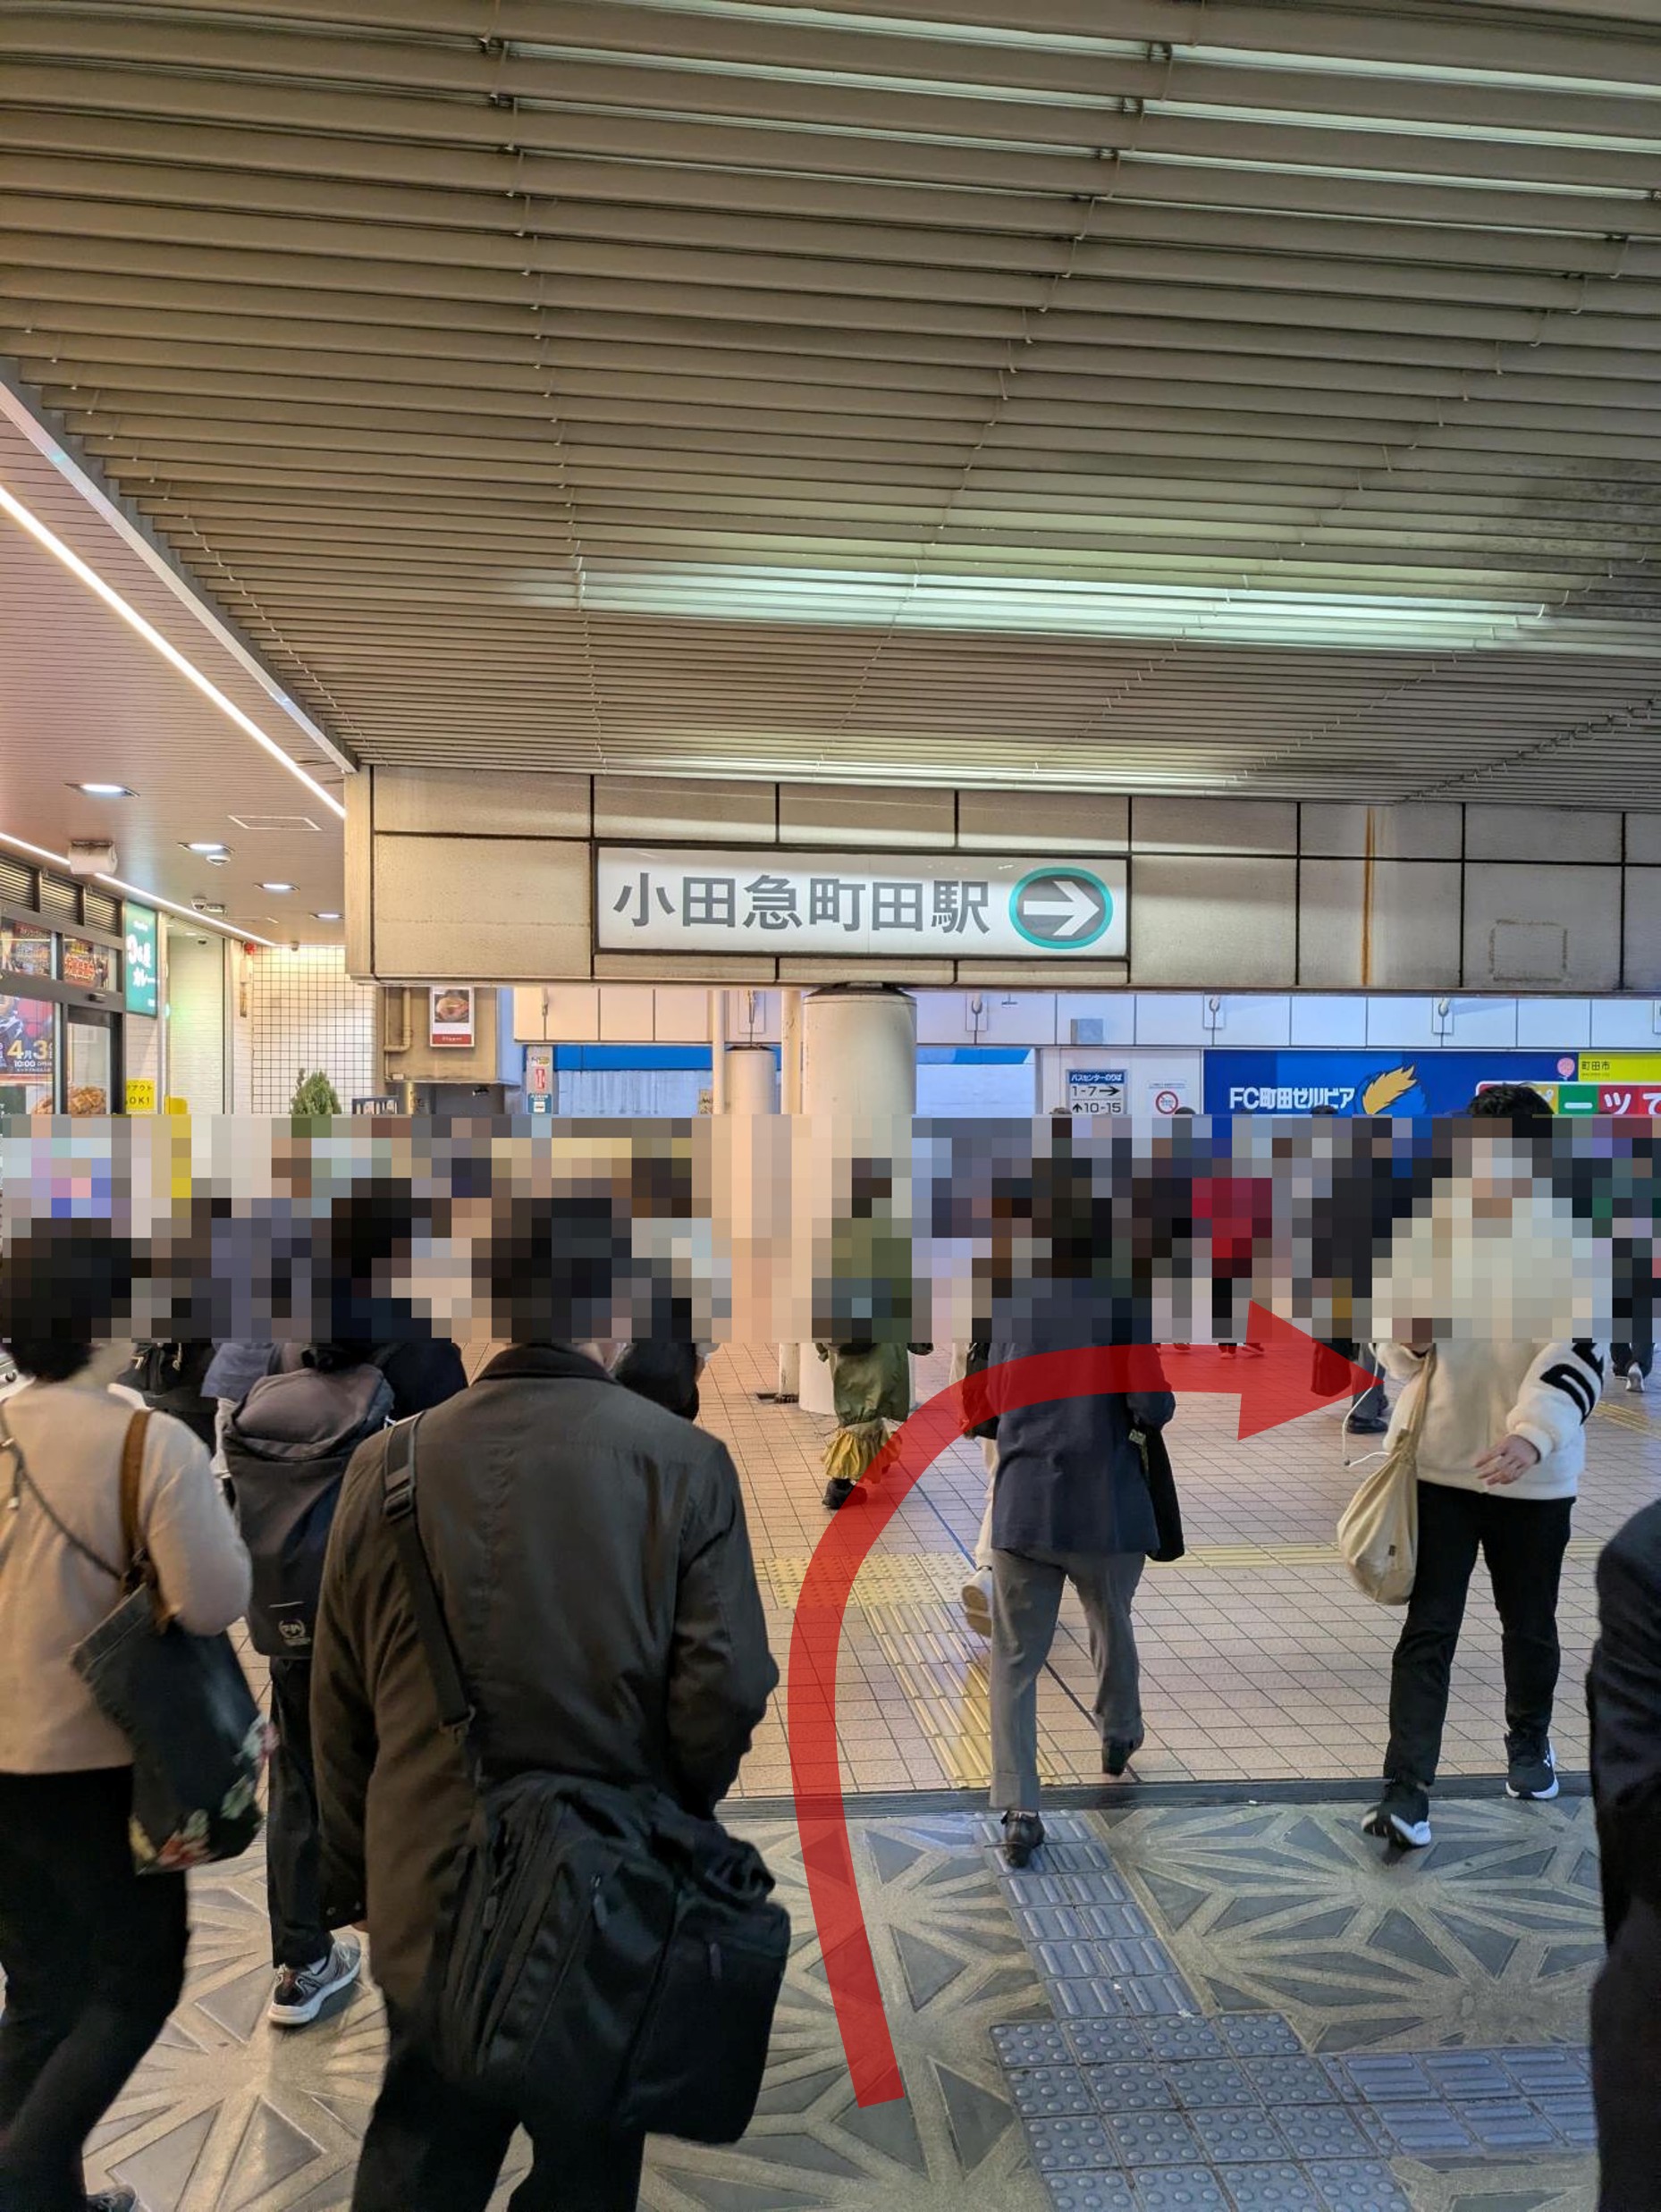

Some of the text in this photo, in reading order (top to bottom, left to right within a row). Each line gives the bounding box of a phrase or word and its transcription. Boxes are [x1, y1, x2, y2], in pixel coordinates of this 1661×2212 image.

[612, 871, 990, 934] 小田急町田駅
[1581, 1061, 1611, 1072] 町田市
[1229, 1087, 1355, 1110] FC町田ゼルビア
[1084, 1102, 1122, 1114] 10-15
